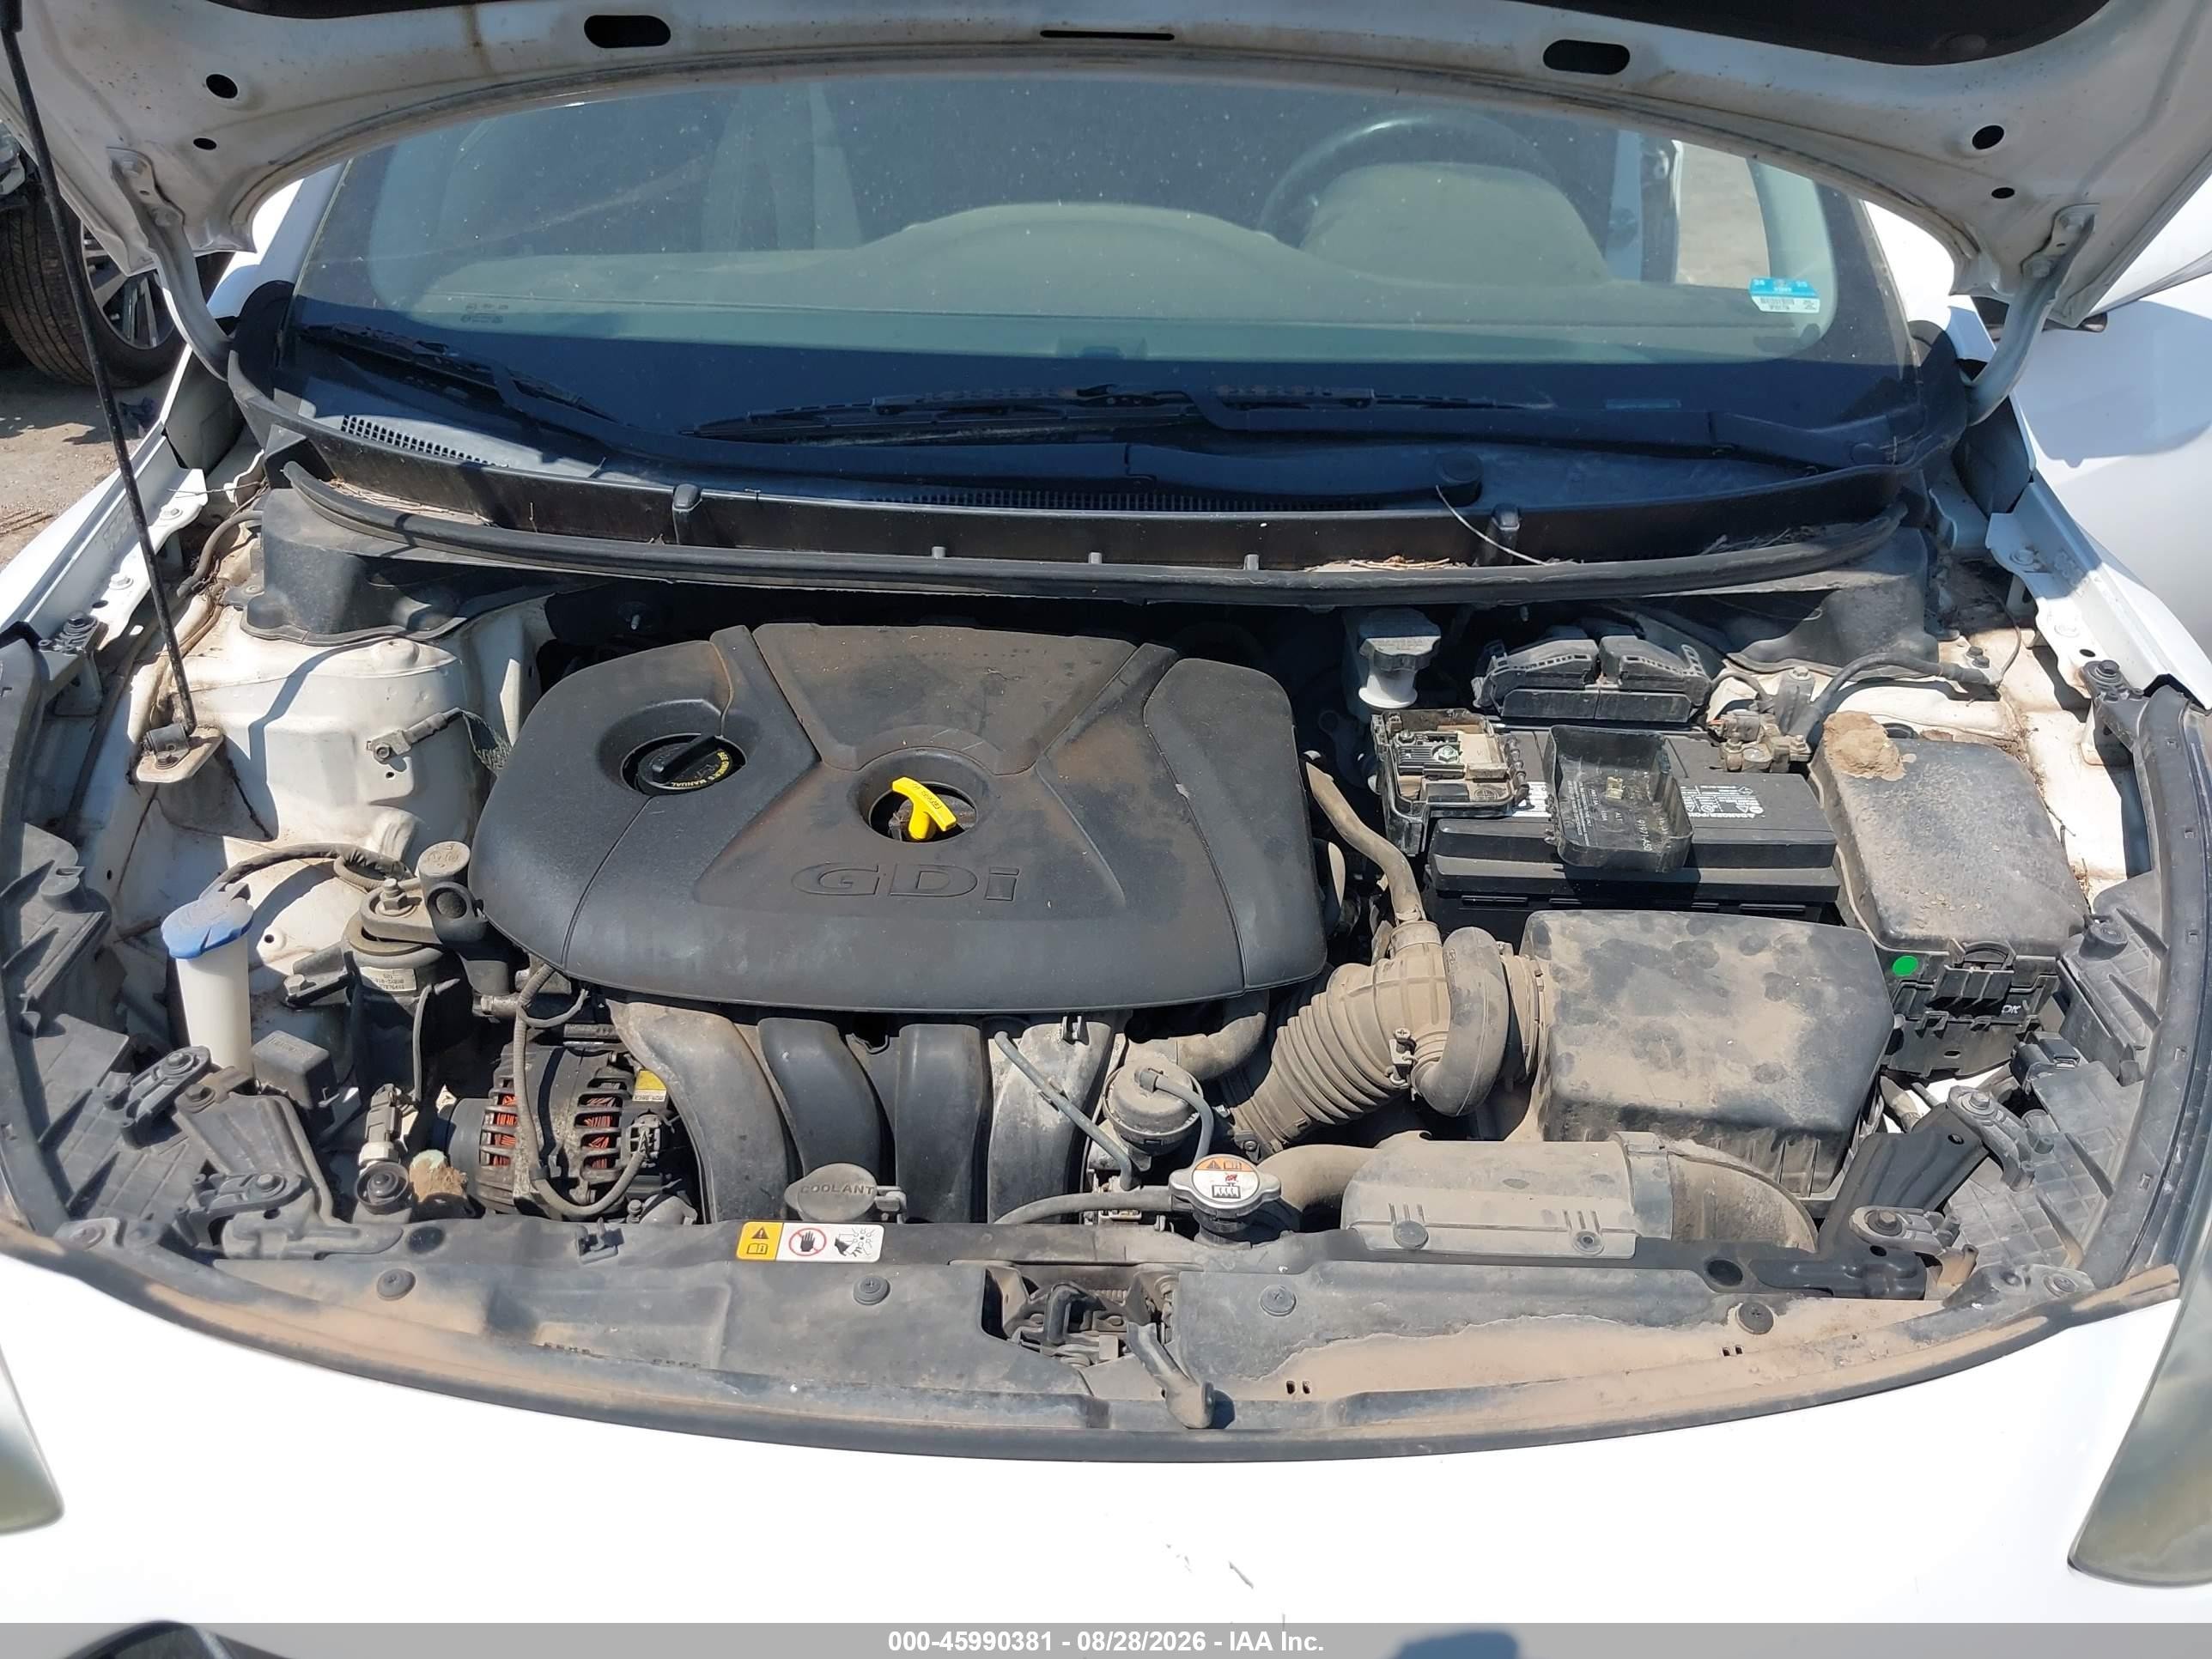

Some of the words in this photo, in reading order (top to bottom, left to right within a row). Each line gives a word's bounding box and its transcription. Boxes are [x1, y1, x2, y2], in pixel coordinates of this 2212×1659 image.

[671, 779, 707, 787] MANUAL
[1636, 818, 1653, 852] 91971-A50
[800, 1184, 875, 1195] COOLANT
